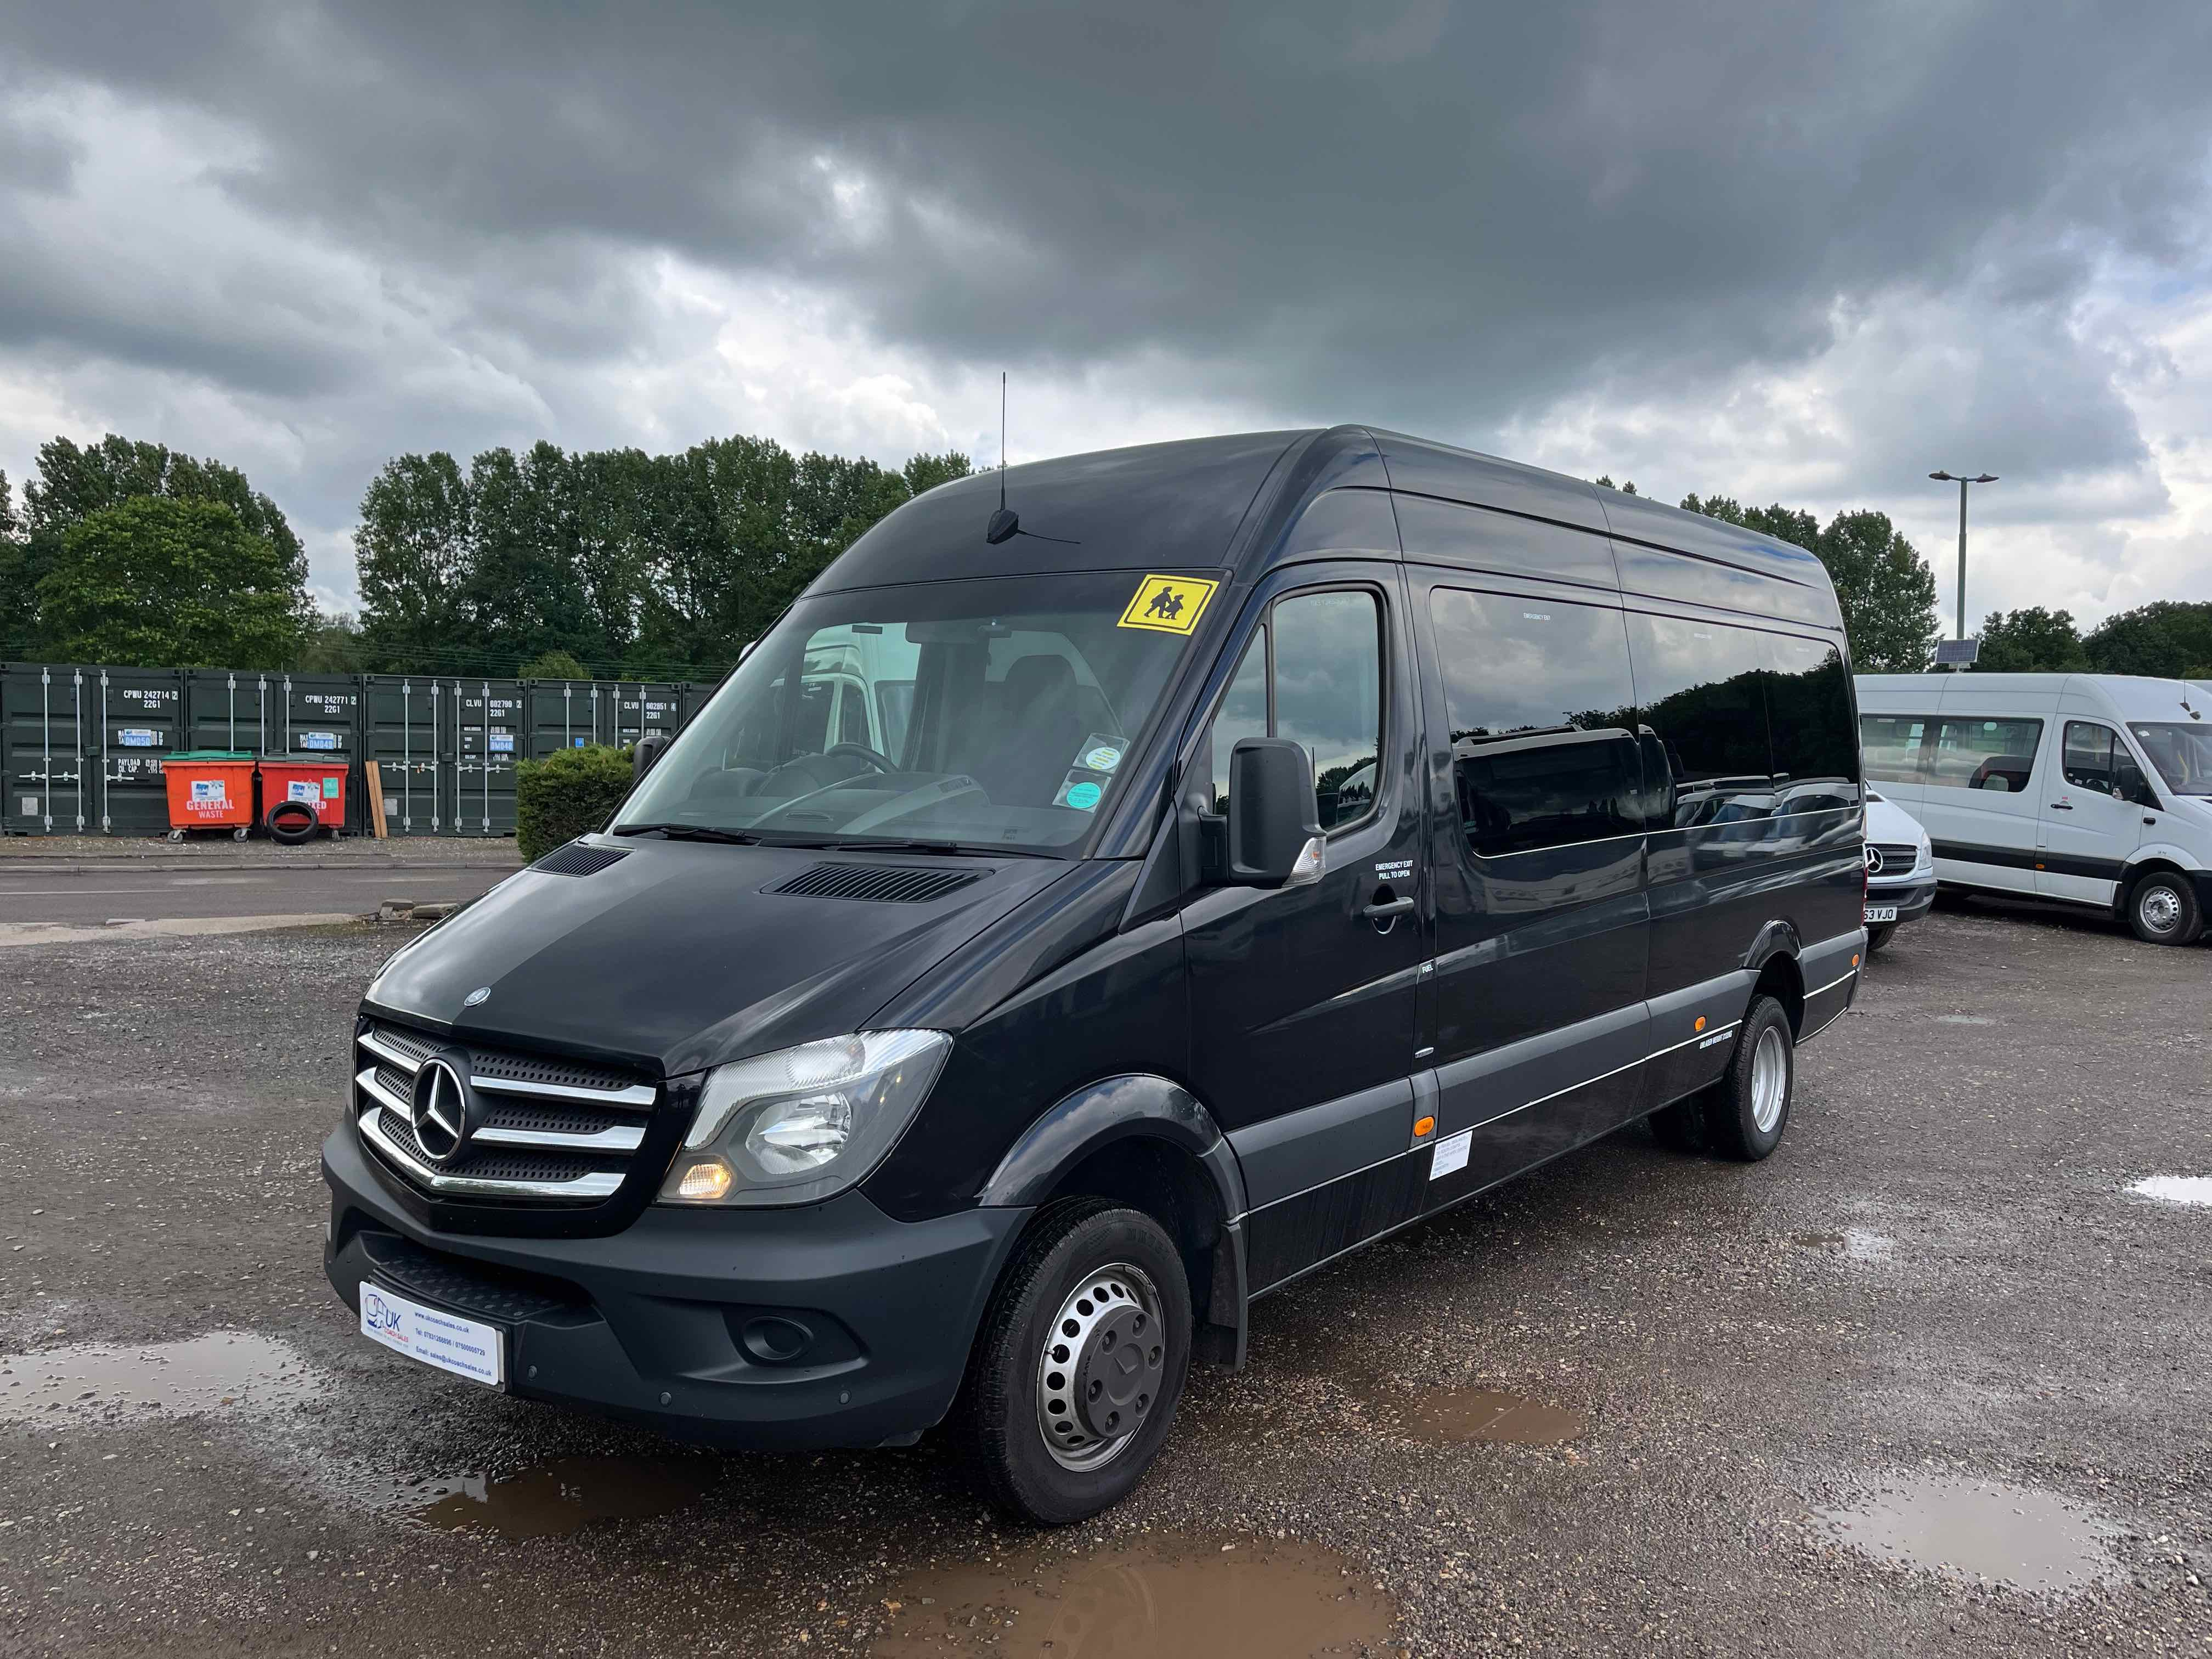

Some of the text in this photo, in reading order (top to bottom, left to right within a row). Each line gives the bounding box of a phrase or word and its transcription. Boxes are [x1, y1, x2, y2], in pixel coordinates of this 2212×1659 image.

[144, 690, 170, 699] 242714
[143, 699, 161, 709] 22G1
[324, 695, 348, 705] 242771
[466, 699, 482, 707] CLVU
[324, 705, 340, 714] 22G1
[624, 701, 639, 710] CLVU
[490, 709, 505, 717] 22G1
[118, 758, 140, 767] PAYLOAD
[187, 799, 235, 811] GENERAL
[199, 810, 224, 819] WASTE
[1375, 861, 1403, 871] EMERGENCY
[1398, 870, 1410, 878] OPEN
[1878, 909, 1893, 919] VJO
[386, 1310, 402, 1331] UK
[415, 1311, 470, 1333] www.ukcoachsales.co.uk
[383, 1325, 397, 1339] COACH
[397, 1333, 409, 1343] SALES
[415, 1328, 424, 1337] Tel:
[416, 1346, 492, 1377] Email: sales@ukcoachsales.co.uk
